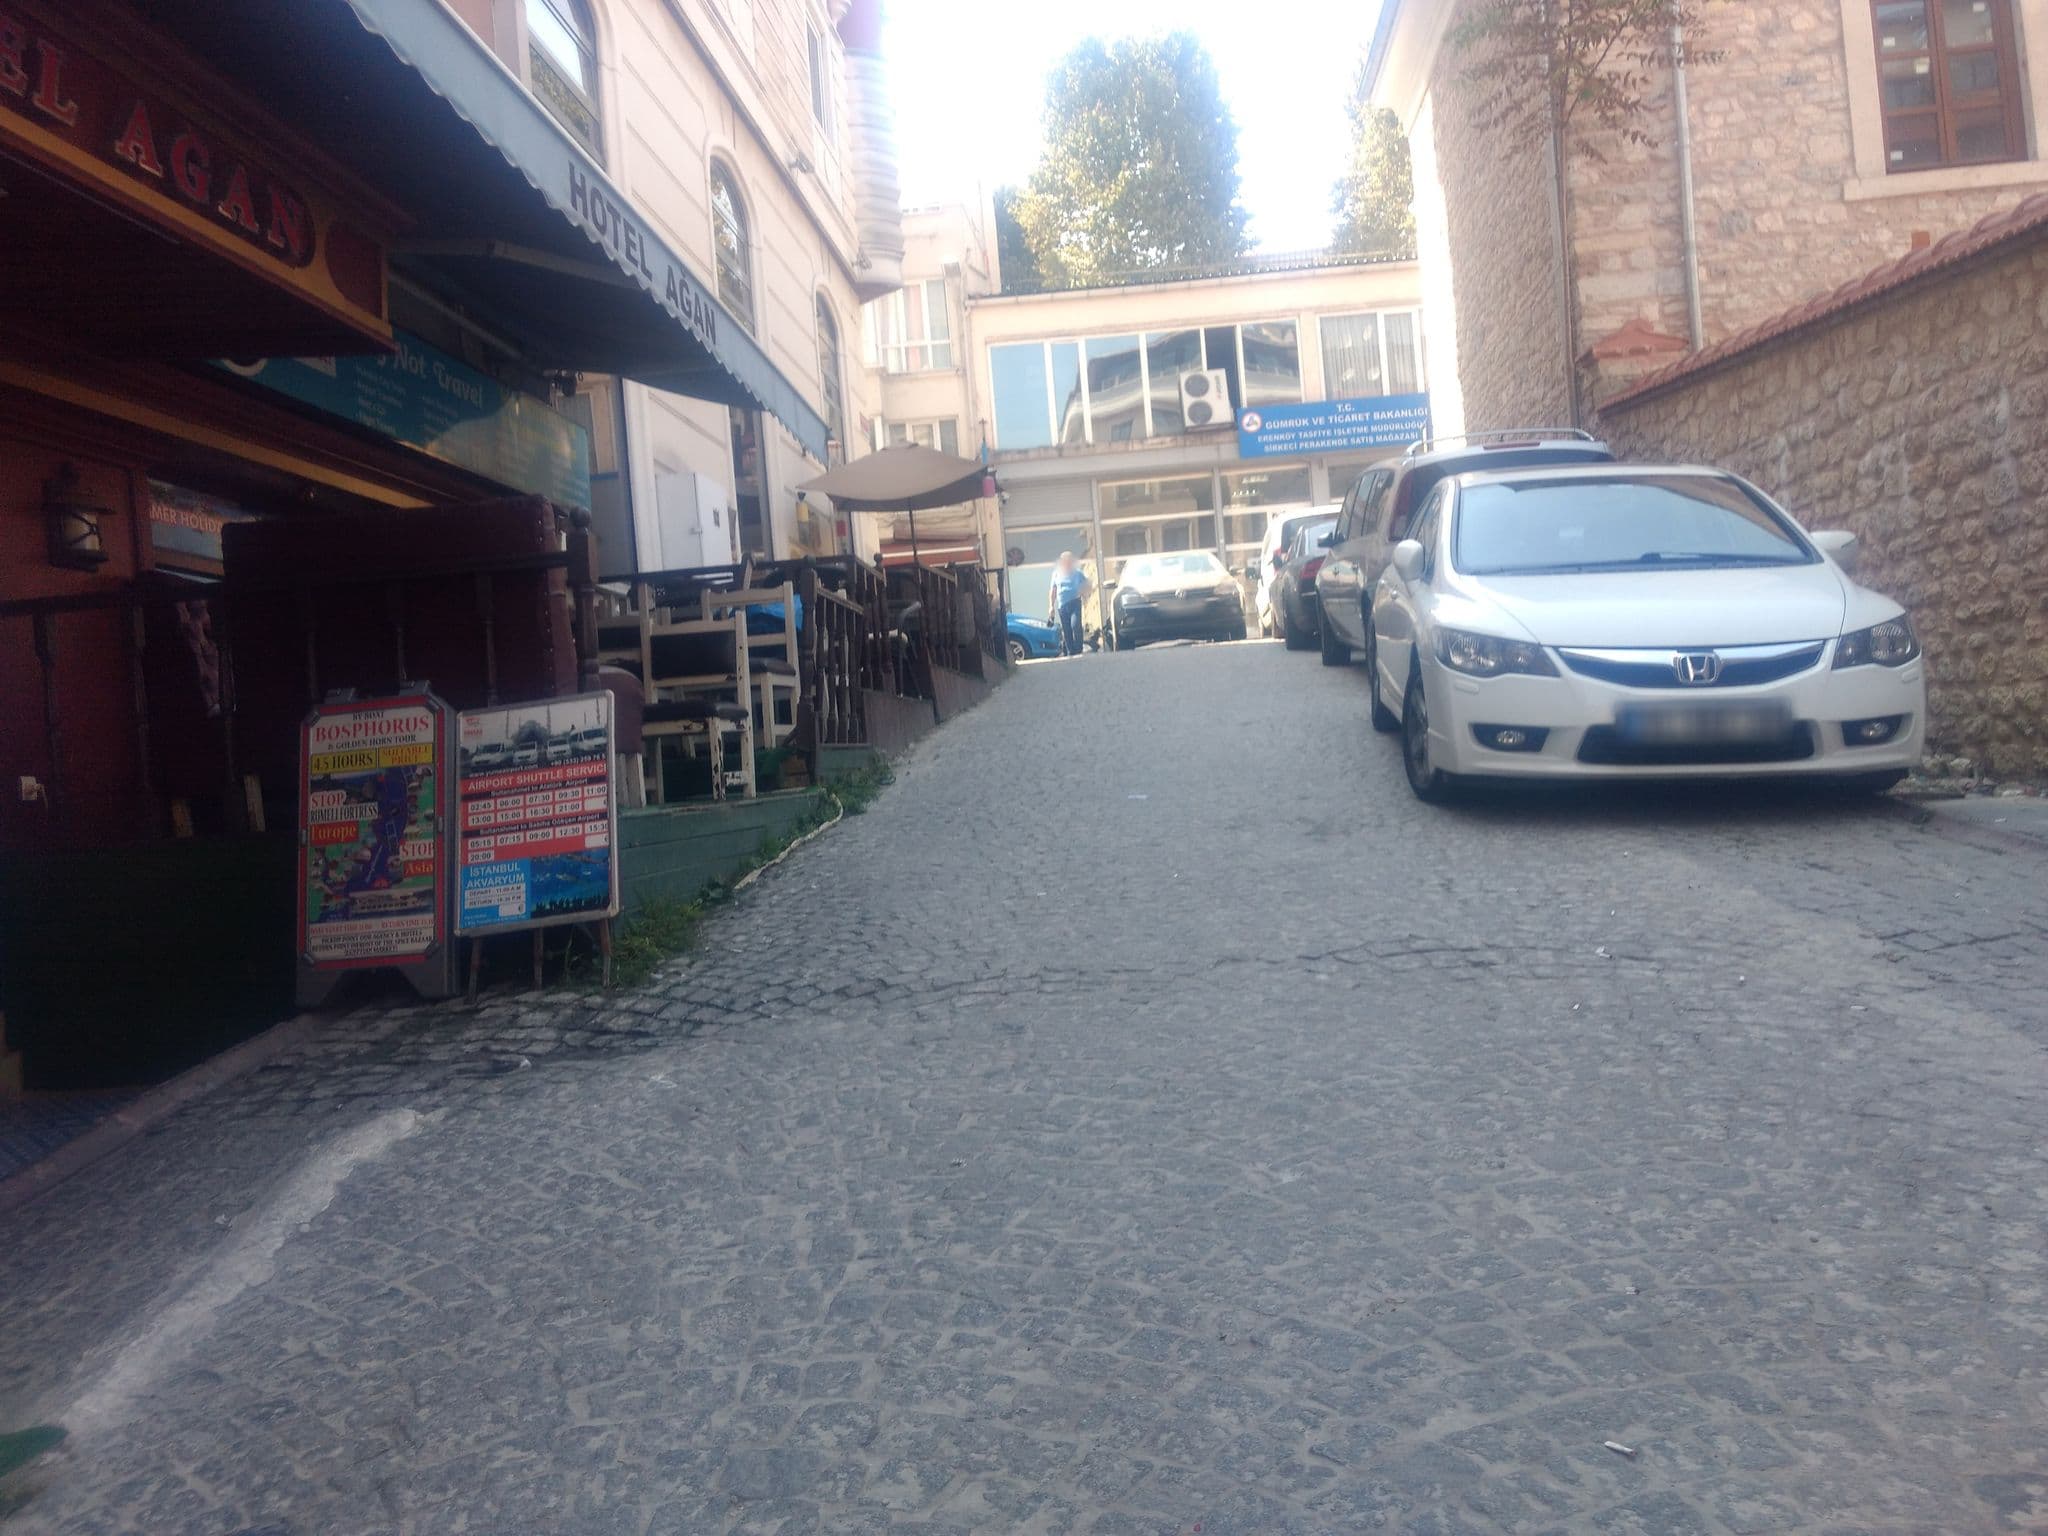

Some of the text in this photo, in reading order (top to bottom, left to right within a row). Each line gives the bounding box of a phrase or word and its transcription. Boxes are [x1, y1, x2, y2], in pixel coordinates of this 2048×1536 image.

[569, 159, 652, 283] HOTEL
[393, 342, 426, 379] Not
[433, 360, 482, 408] Travel
[1337, 403, 1355, 412] T.C.
[1312, 415, 1325, 425] VE
[1328, 412, 1370, 425] TİCARET
[315, 715, 429, 742] BOSPHORUS
[336, 738, 367, 750] GOLDEN
[369, 736, 392, 746] HORN
[396, 734, 416, 744] TOUR
[331, 752, 373, 769] HOURS
[468, 777, 513, 791] AIRPORT
[516, 770, 563, 785] SHUTTLE
[565, 778, 588, 788] Airport
[311, 792, 344, 807] STOP
[528, 794, 550, 803] 07:30
[586, 786, 606, 795] 11:00
[340, 803, 378, 821] FORTRESS
[559, 803, 579, 812] 21:00
[578, 814, 600, 823] Airport
[311, 823, 357, 843] Europe
[529, 831, 550, 840] 09:00
[470, 852, 491, 860] 20:00
[470, 862, 521, 877] İSTANBUL
[466, 873, 525, 889] AKVARYUM
